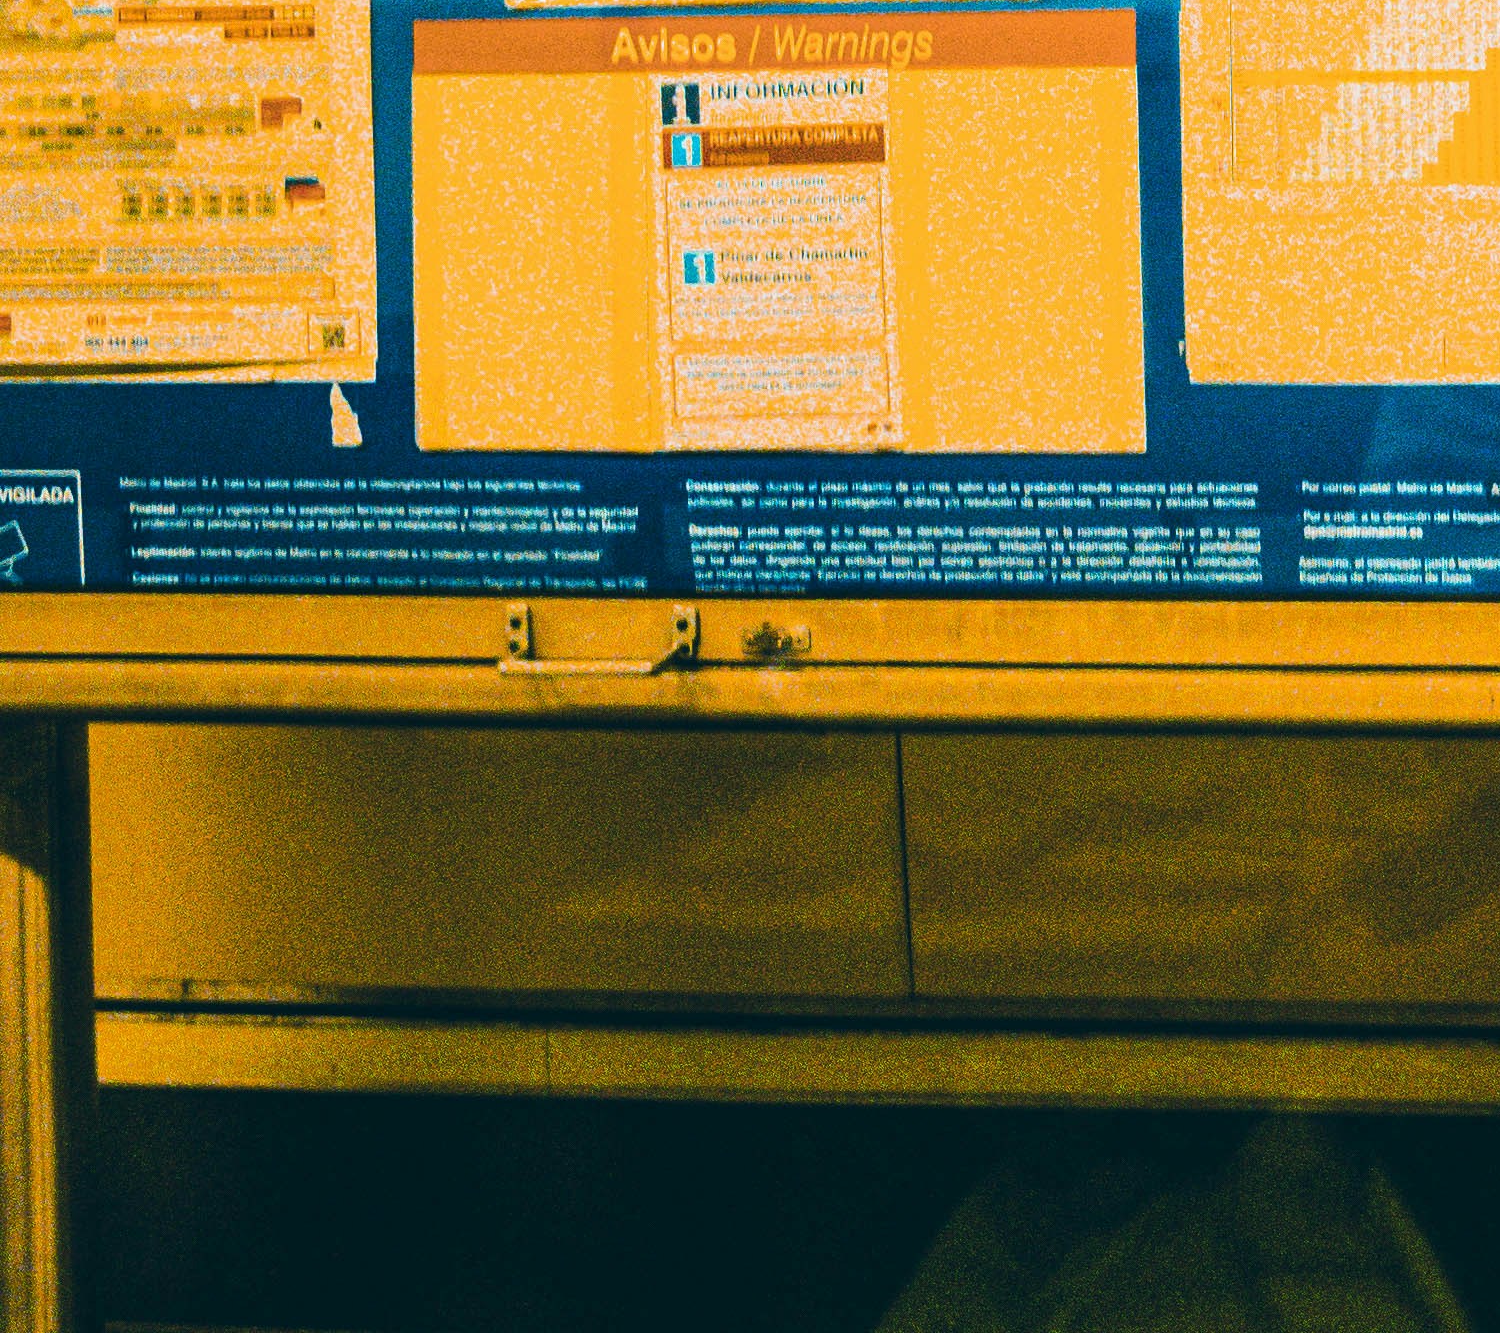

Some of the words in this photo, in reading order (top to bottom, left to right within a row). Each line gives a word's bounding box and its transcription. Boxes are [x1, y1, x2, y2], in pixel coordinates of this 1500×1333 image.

[611, 25, 738, 64] Avisos
[772, 22, 934, 68] Warnings
[709, 79, 865, 101] INFORMACIÓN
